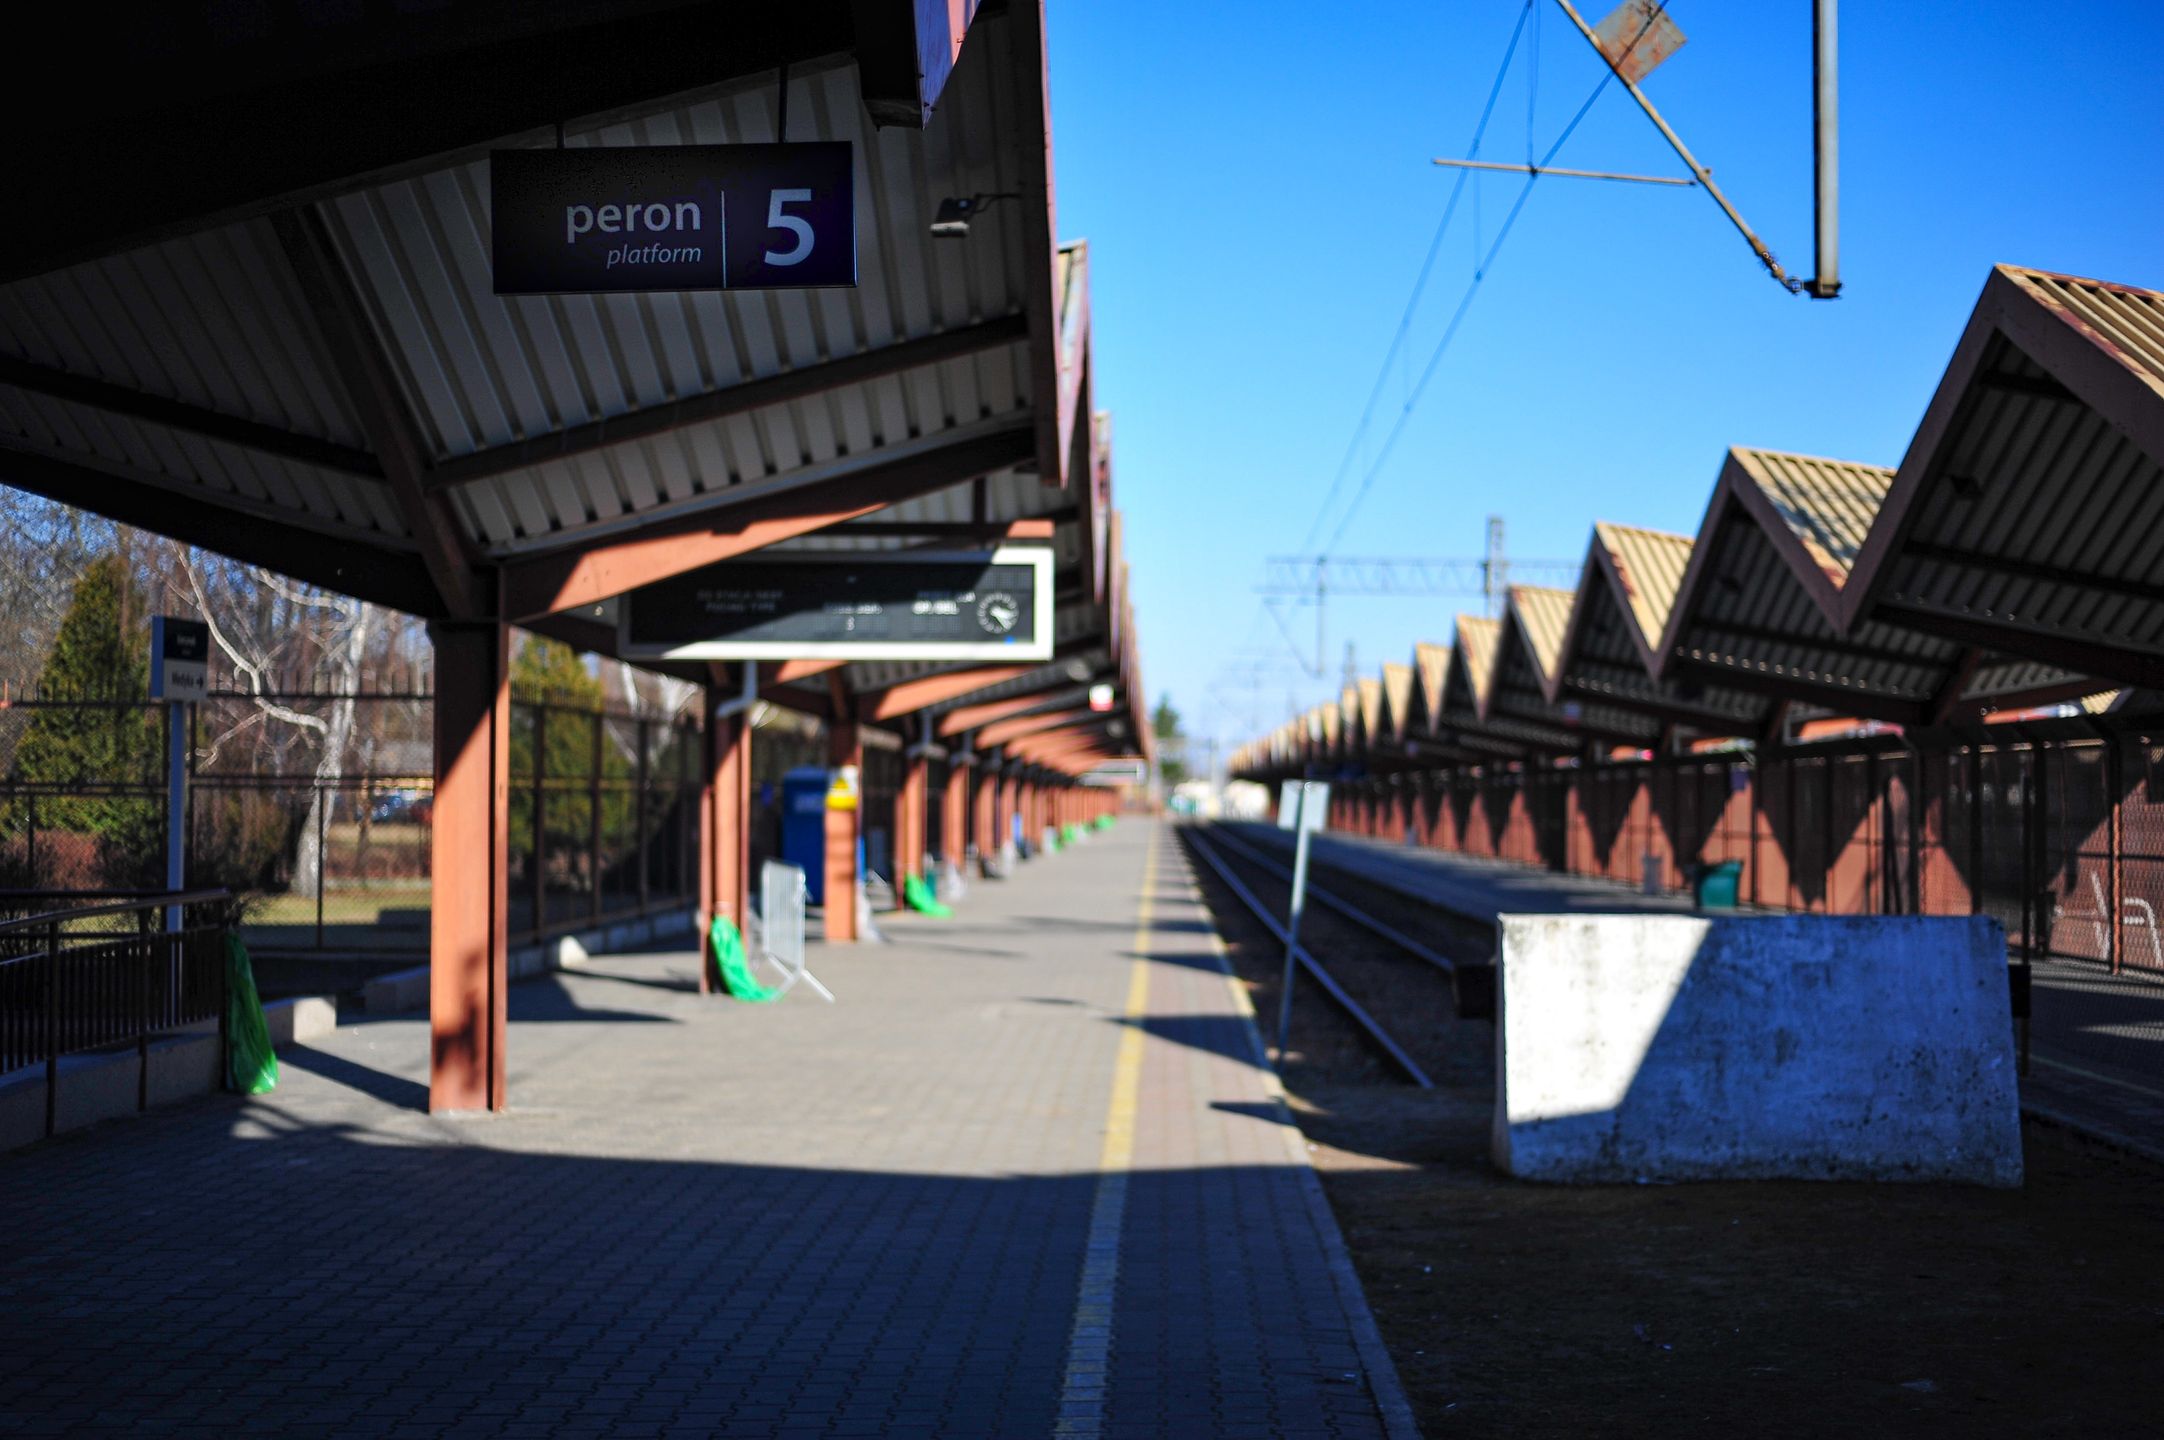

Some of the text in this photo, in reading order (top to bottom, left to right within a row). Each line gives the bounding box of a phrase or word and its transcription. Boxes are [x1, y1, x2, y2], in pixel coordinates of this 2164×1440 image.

[566, 201, 701, 244] peron
[764, 188, 815, 266] 5
[606, 243, 701, 269] platform
